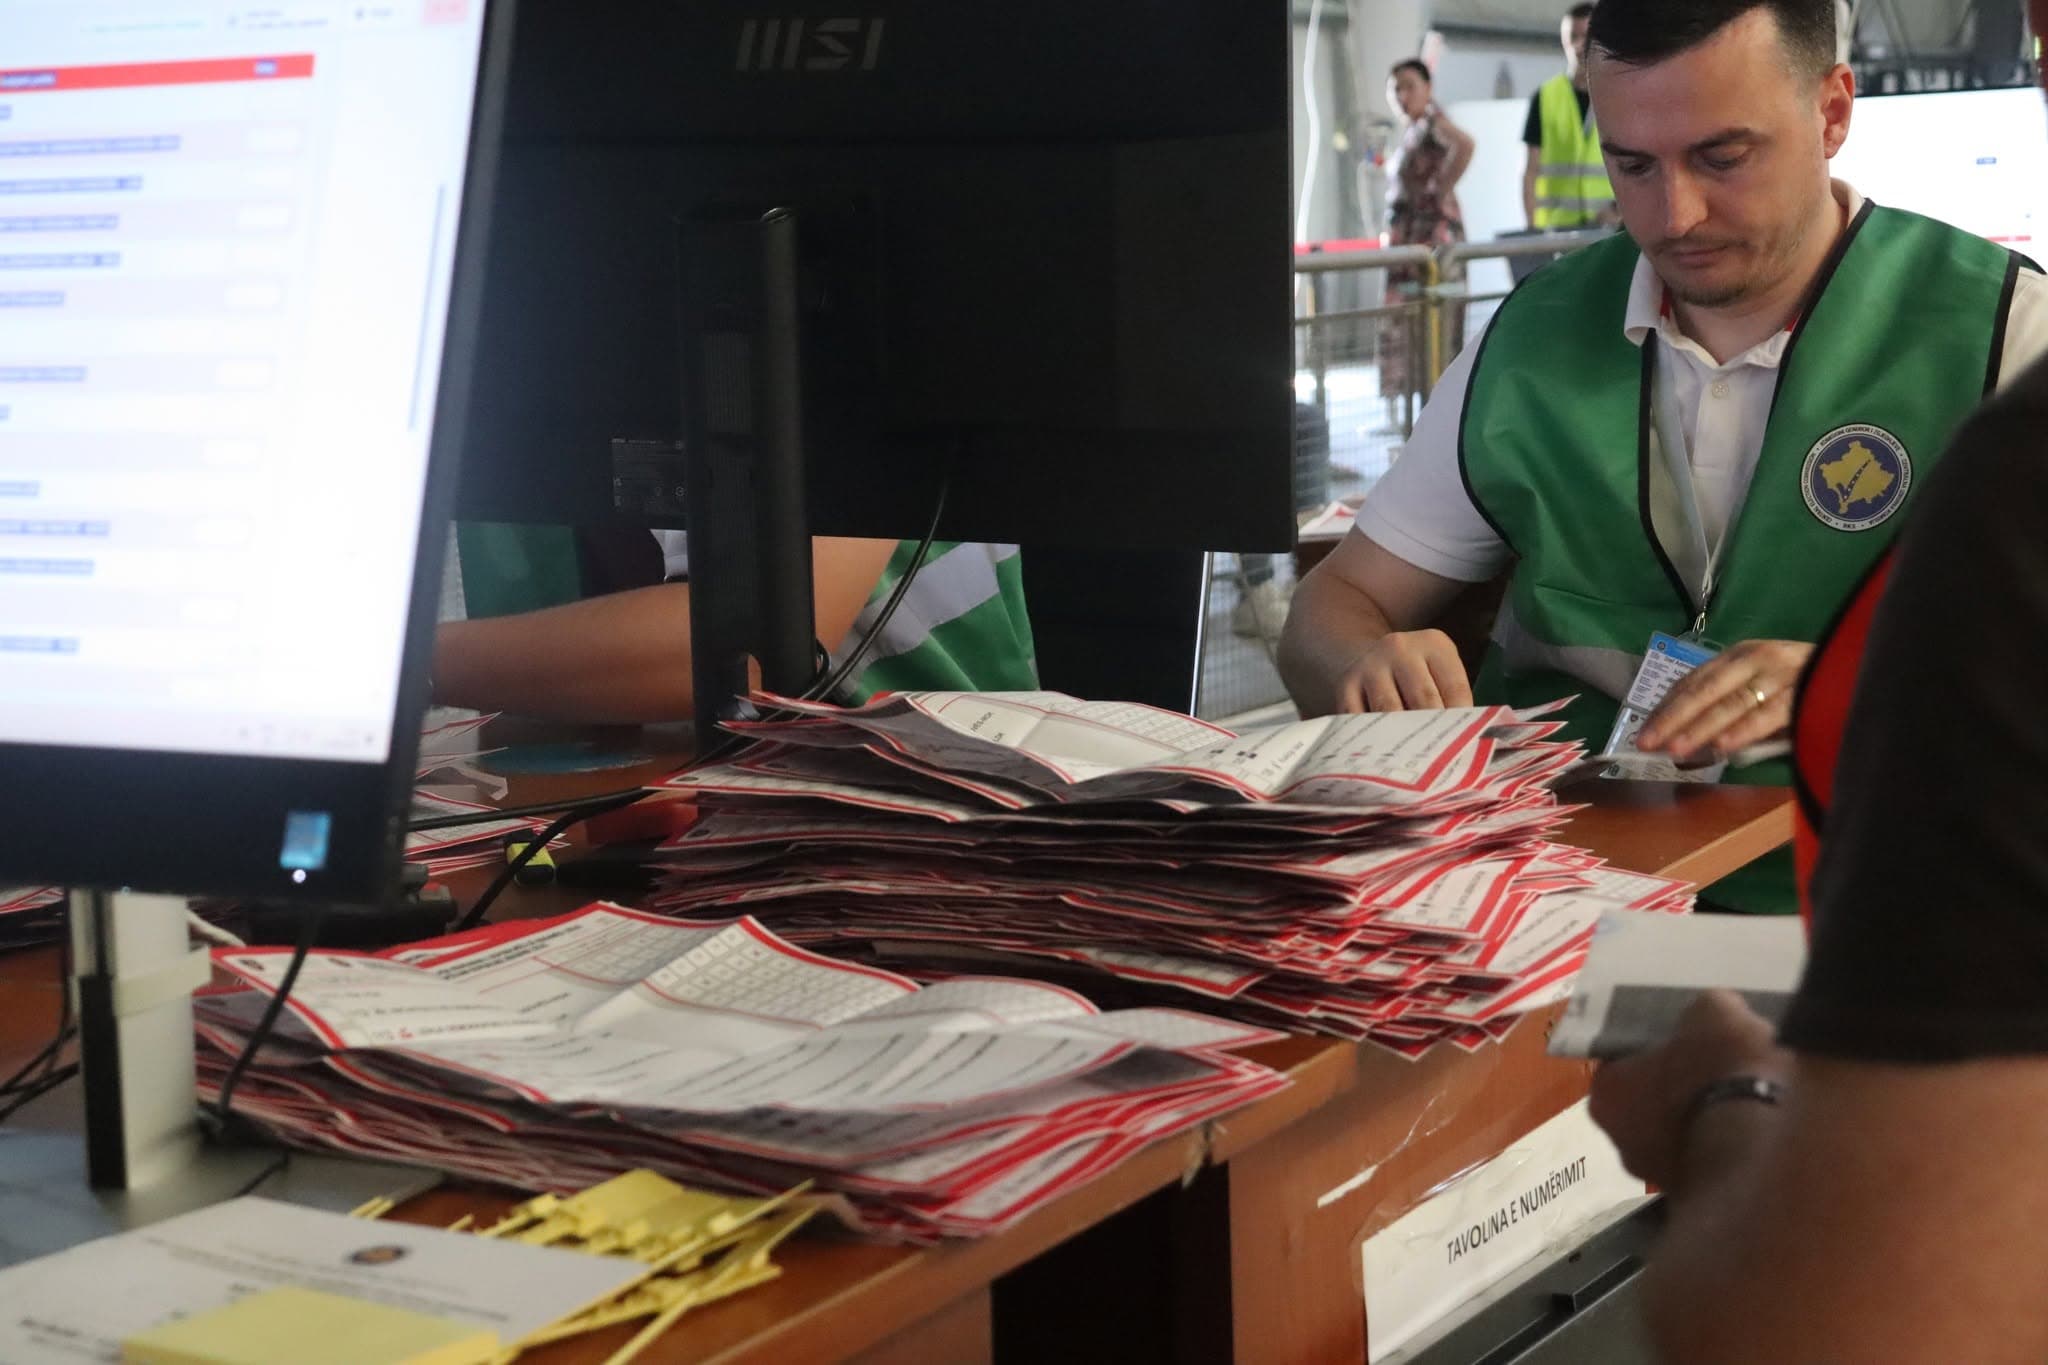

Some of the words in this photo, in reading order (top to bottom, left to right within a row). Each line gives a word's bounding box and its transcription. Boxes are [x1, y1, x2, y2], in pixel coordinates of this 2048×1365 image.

[736, 18, 885, 71] MSI
[1447, 1208, 1509, 1265] TAVOLINA
[1510, 1200, 1518, 1224] E
[1519, 1156, 1586, 1219] NUMËRIMIT
